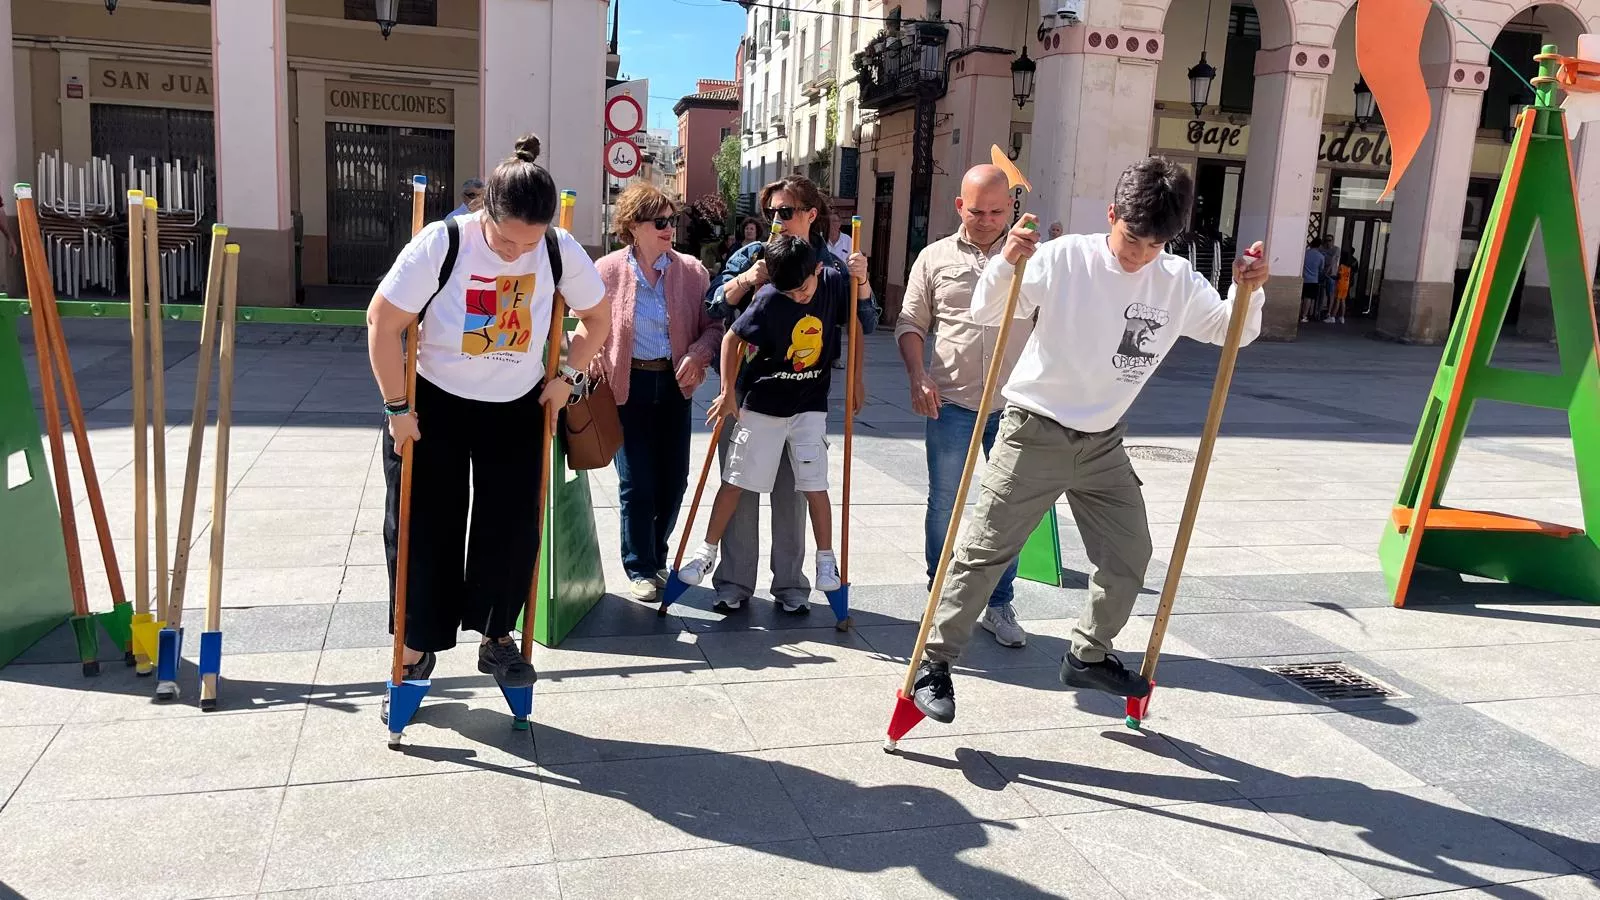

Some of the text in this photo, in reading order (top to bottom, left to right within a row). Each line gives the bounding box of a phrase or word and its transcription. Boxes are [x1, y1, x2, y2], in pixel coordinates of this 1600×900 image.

[102, 70, 213, 95] SAN JUA
[330, 89, 447, 115] CONFECCIONES
